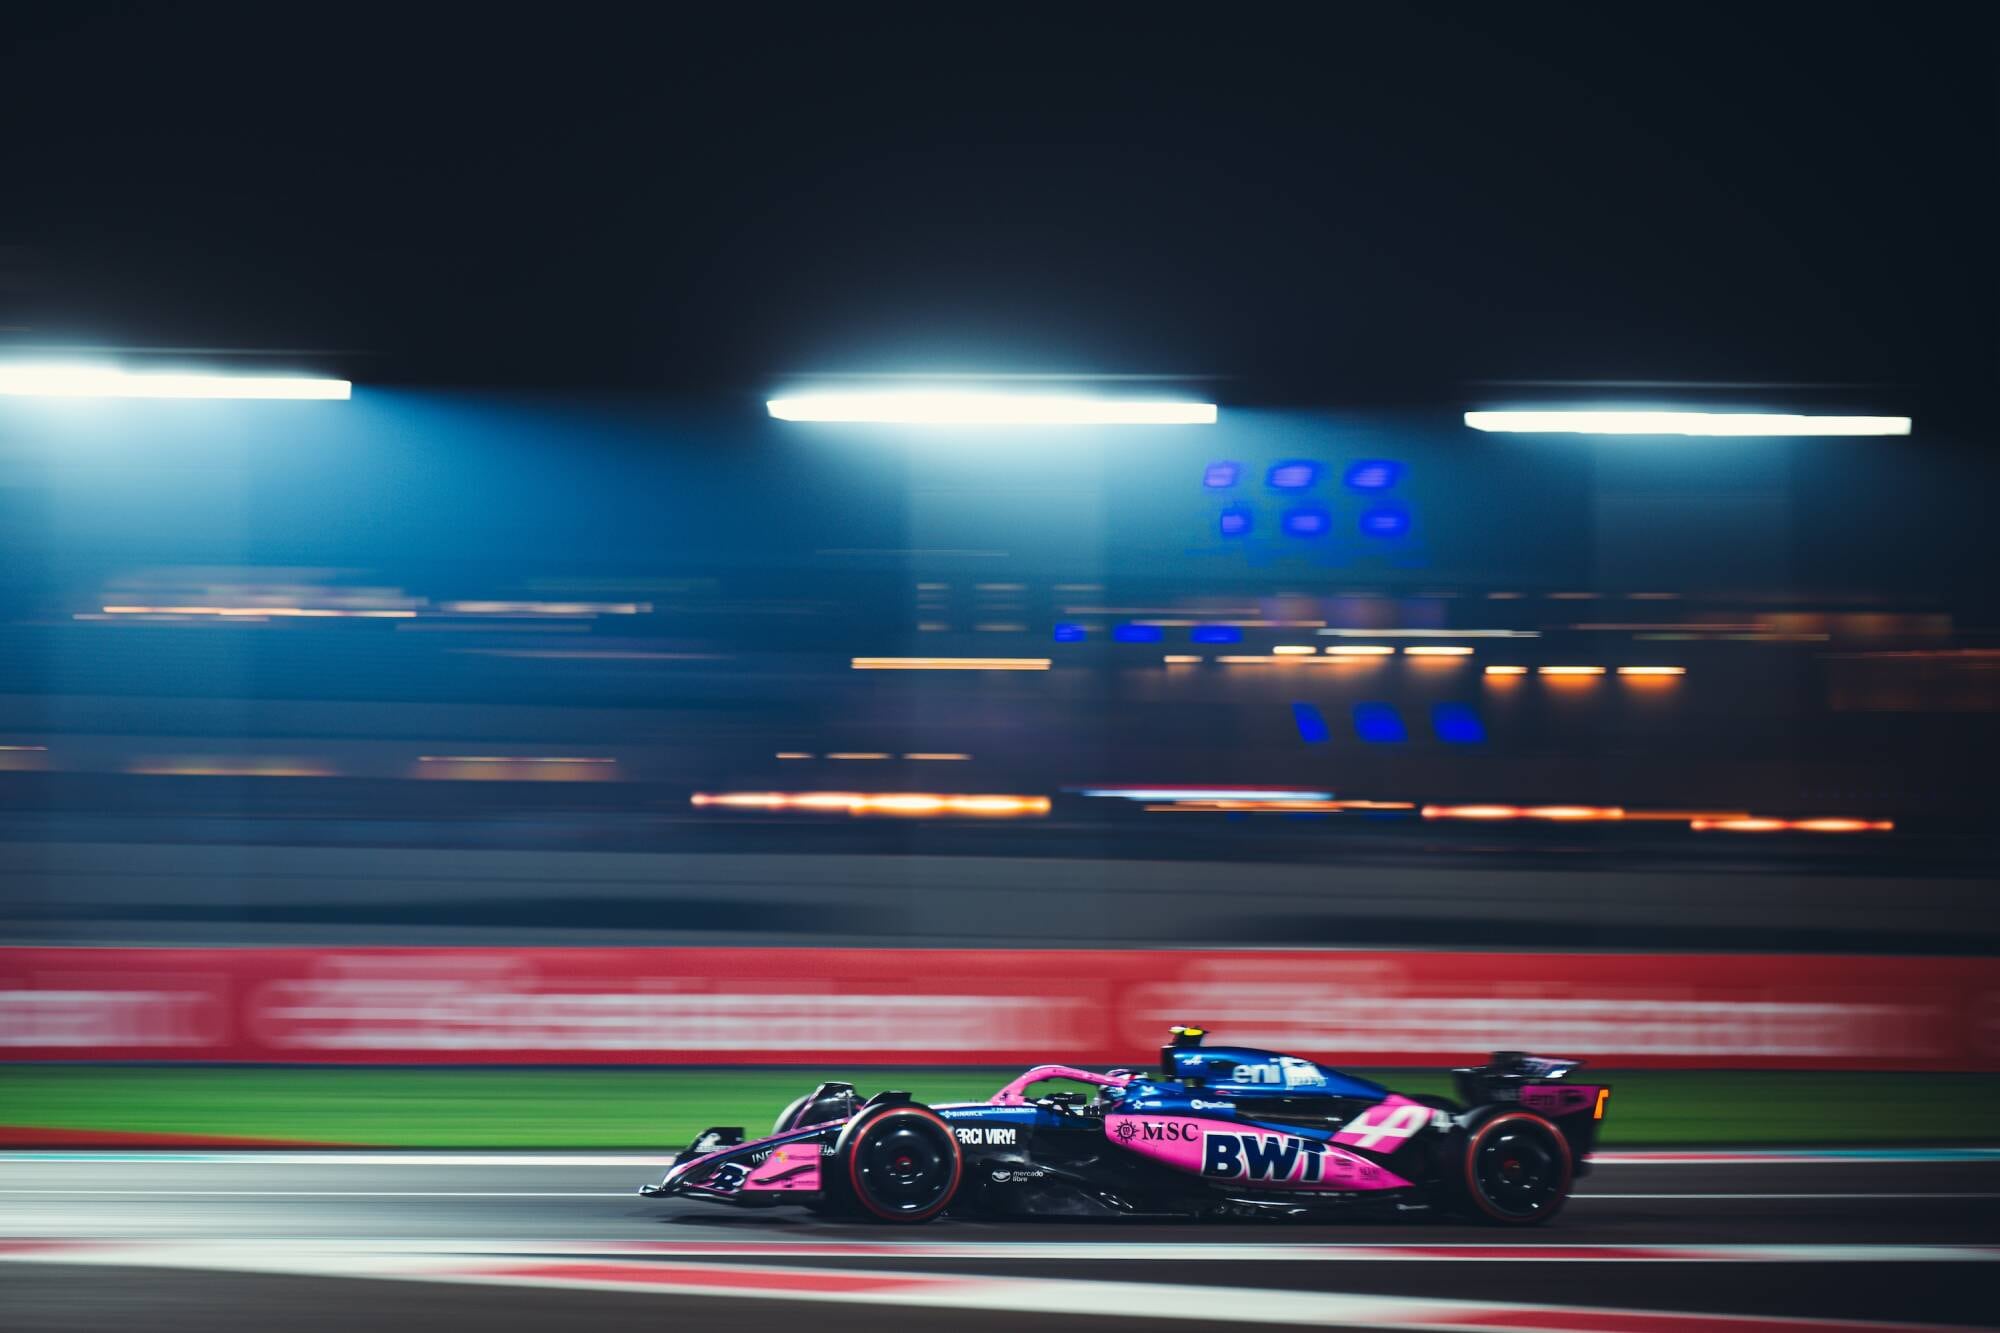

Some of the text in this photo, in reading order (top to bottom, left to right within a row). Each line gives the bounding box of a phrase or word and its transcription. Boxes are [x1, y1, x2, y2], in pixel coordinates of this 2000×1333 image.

[1232, 1063, 1280, 1084] eni
[985, 1128, 1016, 1145] VIRY!
[1142, 1121, 1199, 1141] MSC
[1202, 1131, 1326, 1183] BWT
